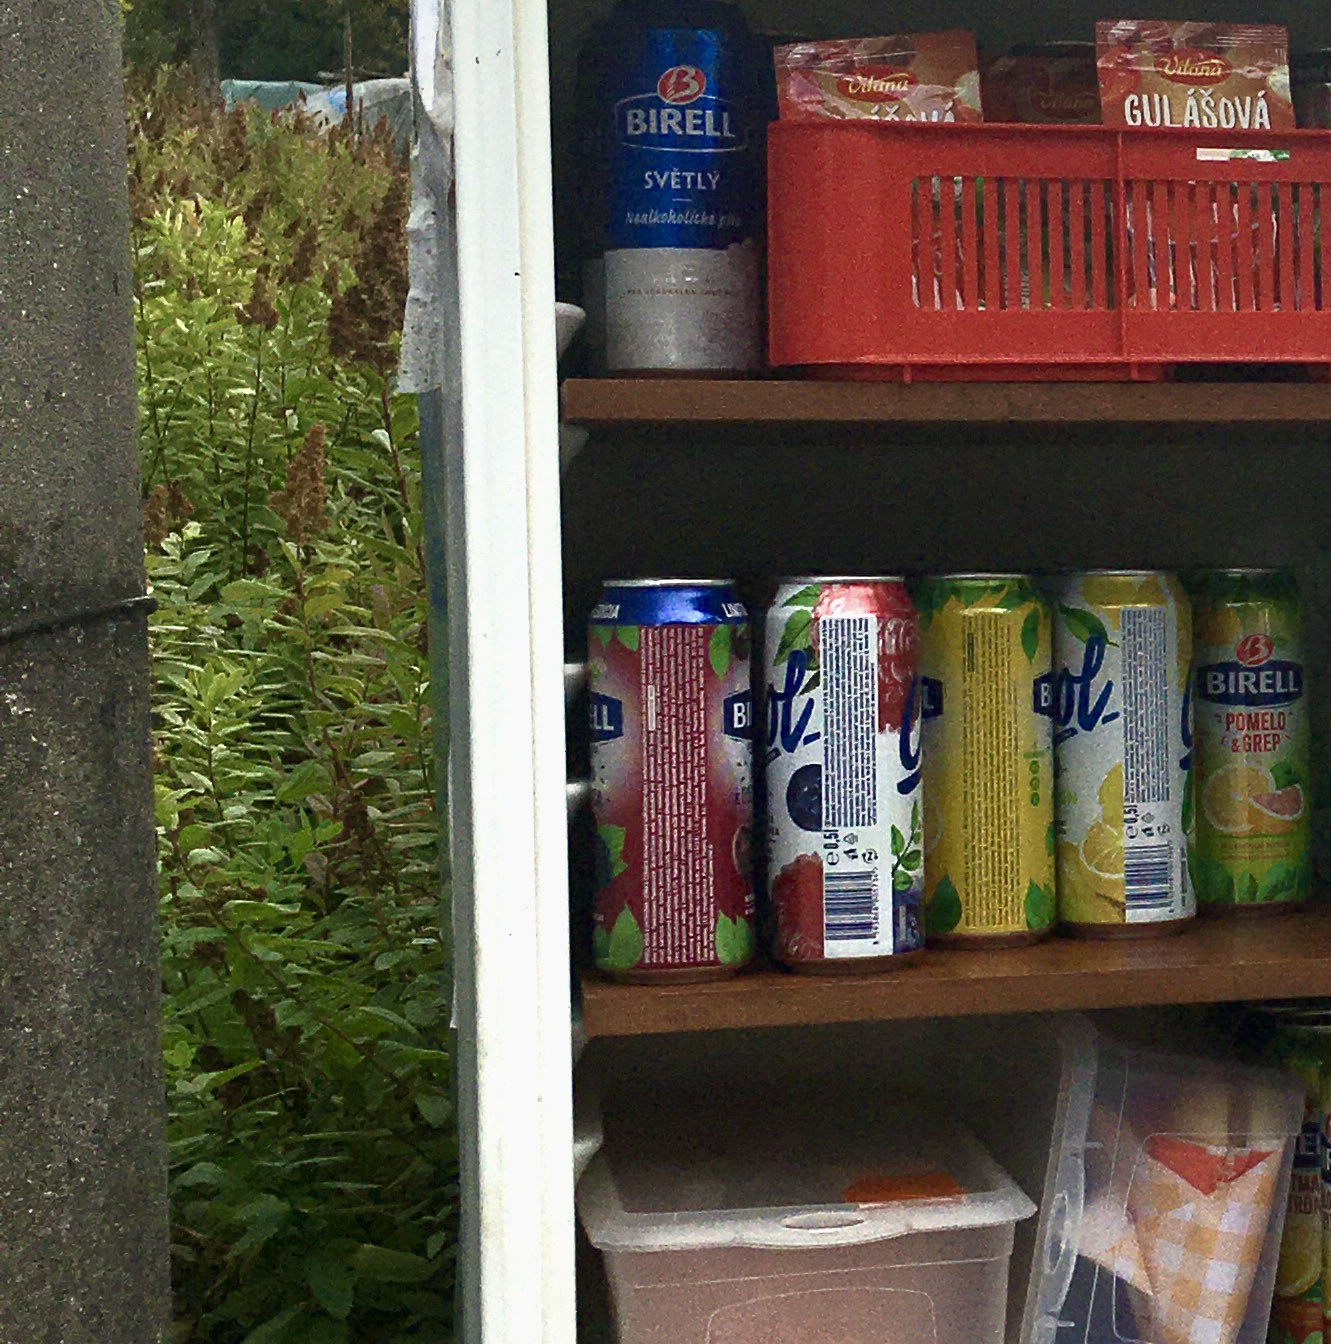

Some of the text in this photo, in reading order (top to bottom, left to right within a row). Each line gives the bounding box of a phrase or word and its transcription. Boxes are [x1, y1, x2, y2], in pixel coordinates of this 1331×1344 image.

[1124, 88, 1271, 131] GULÁŠOVÁ
[625, 108, 736, 138] BIRELL
[644, 167, 720, 190] SVĚTLÝ
[1207, 670, 1299, 695] BIRELL
[1225, 711, 1287, 732] POMELO
[1242, 735, 1282, 754] GREP
